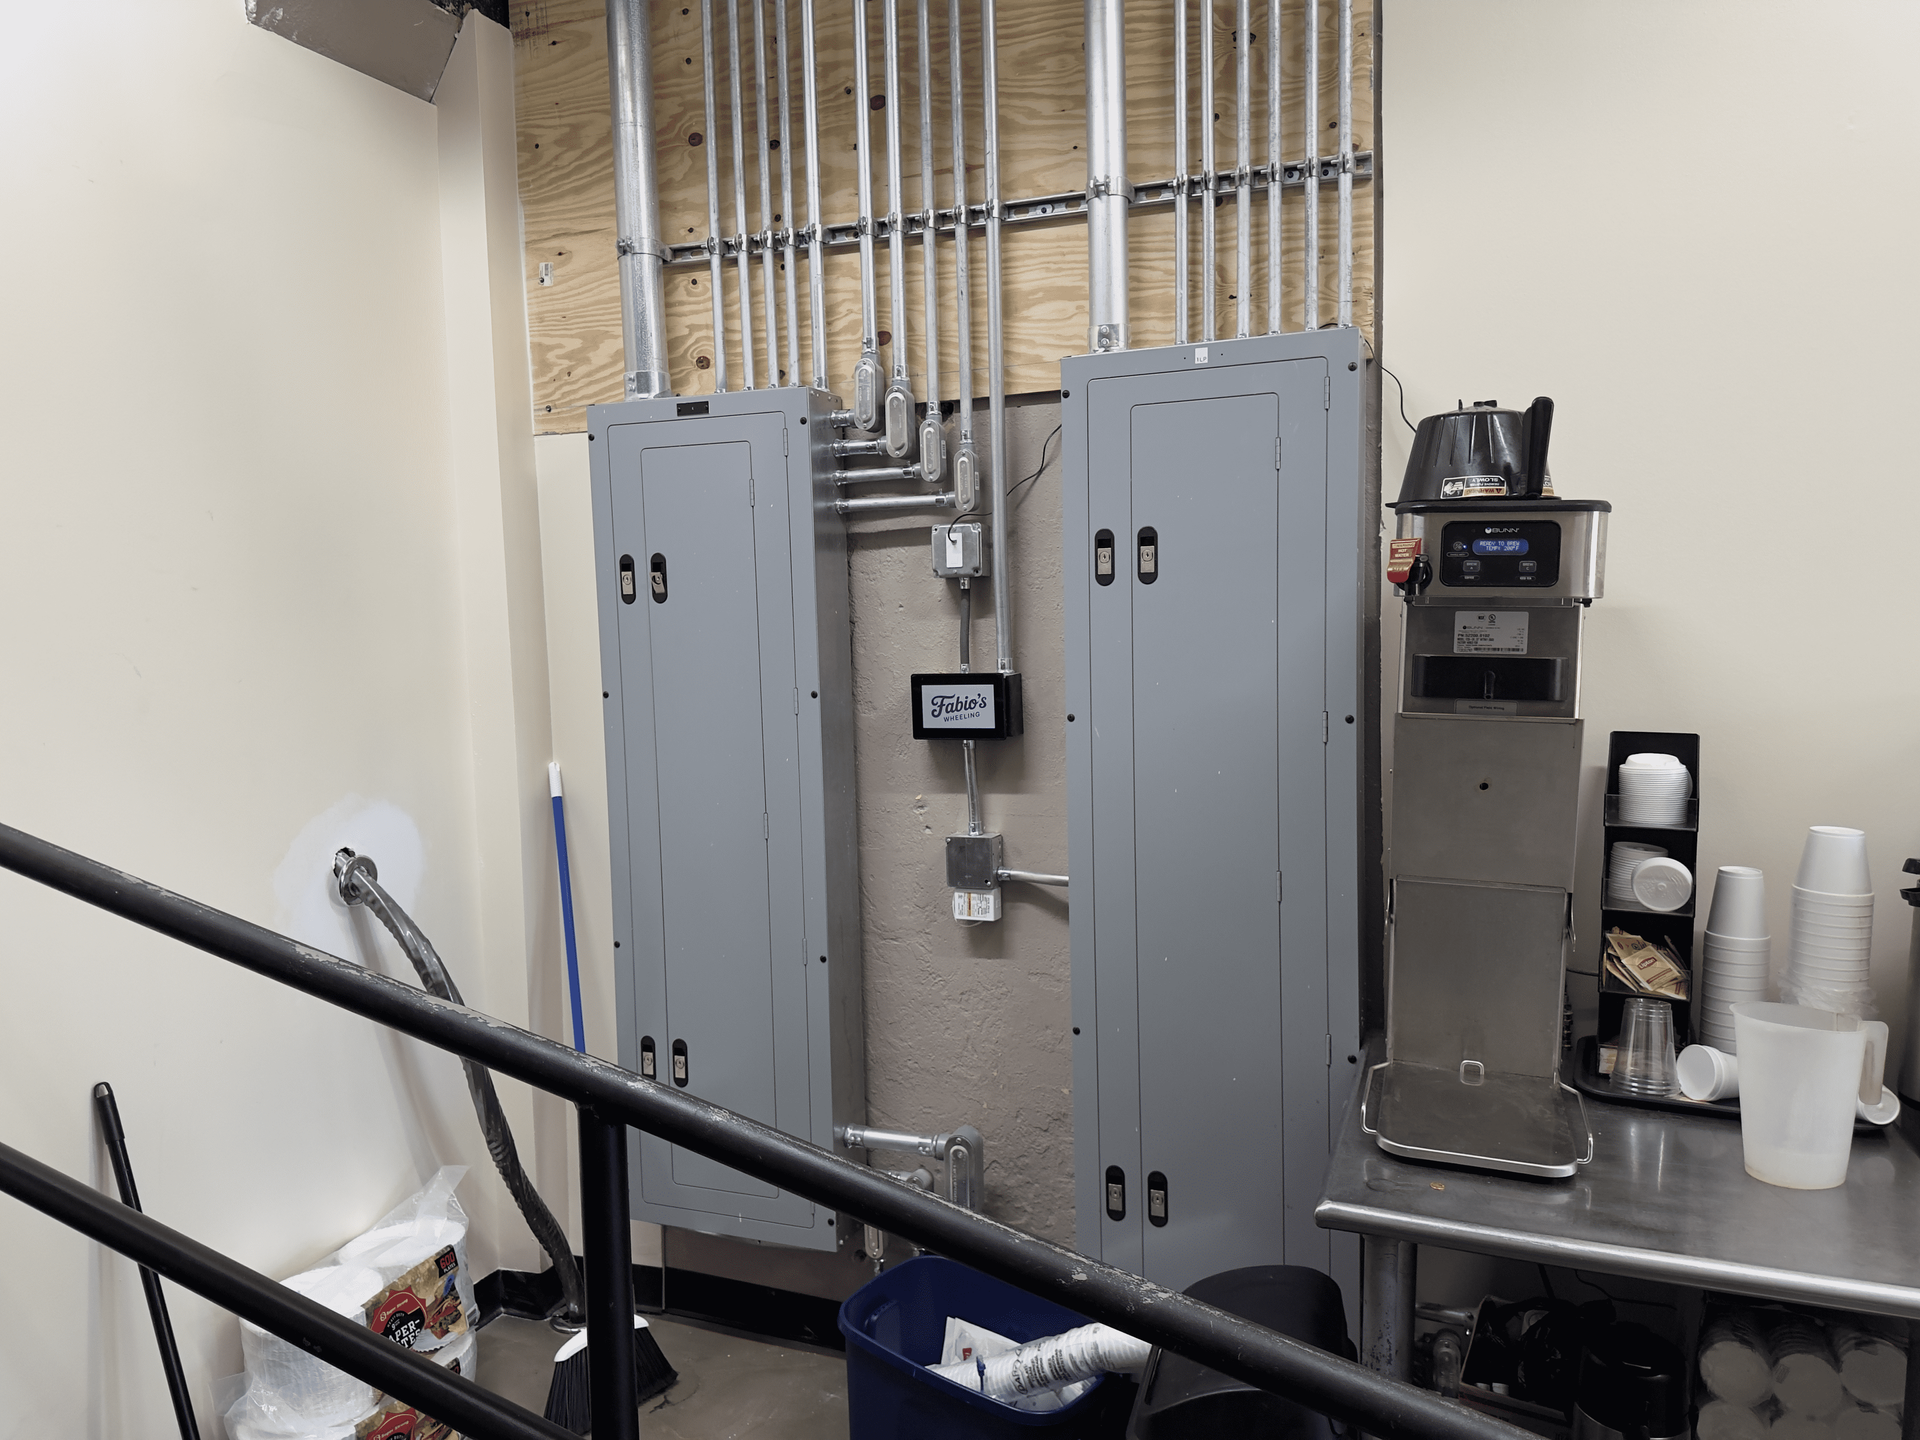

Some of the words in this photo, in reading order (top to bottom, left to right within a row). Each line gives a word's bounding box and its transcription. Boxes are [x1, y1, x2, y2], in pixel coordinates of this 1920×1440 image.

[931, 693, 987, 718] Fabio's
[943, 711, 981, 722] WHEELING
[440, 1251, 455, 1270] 600
